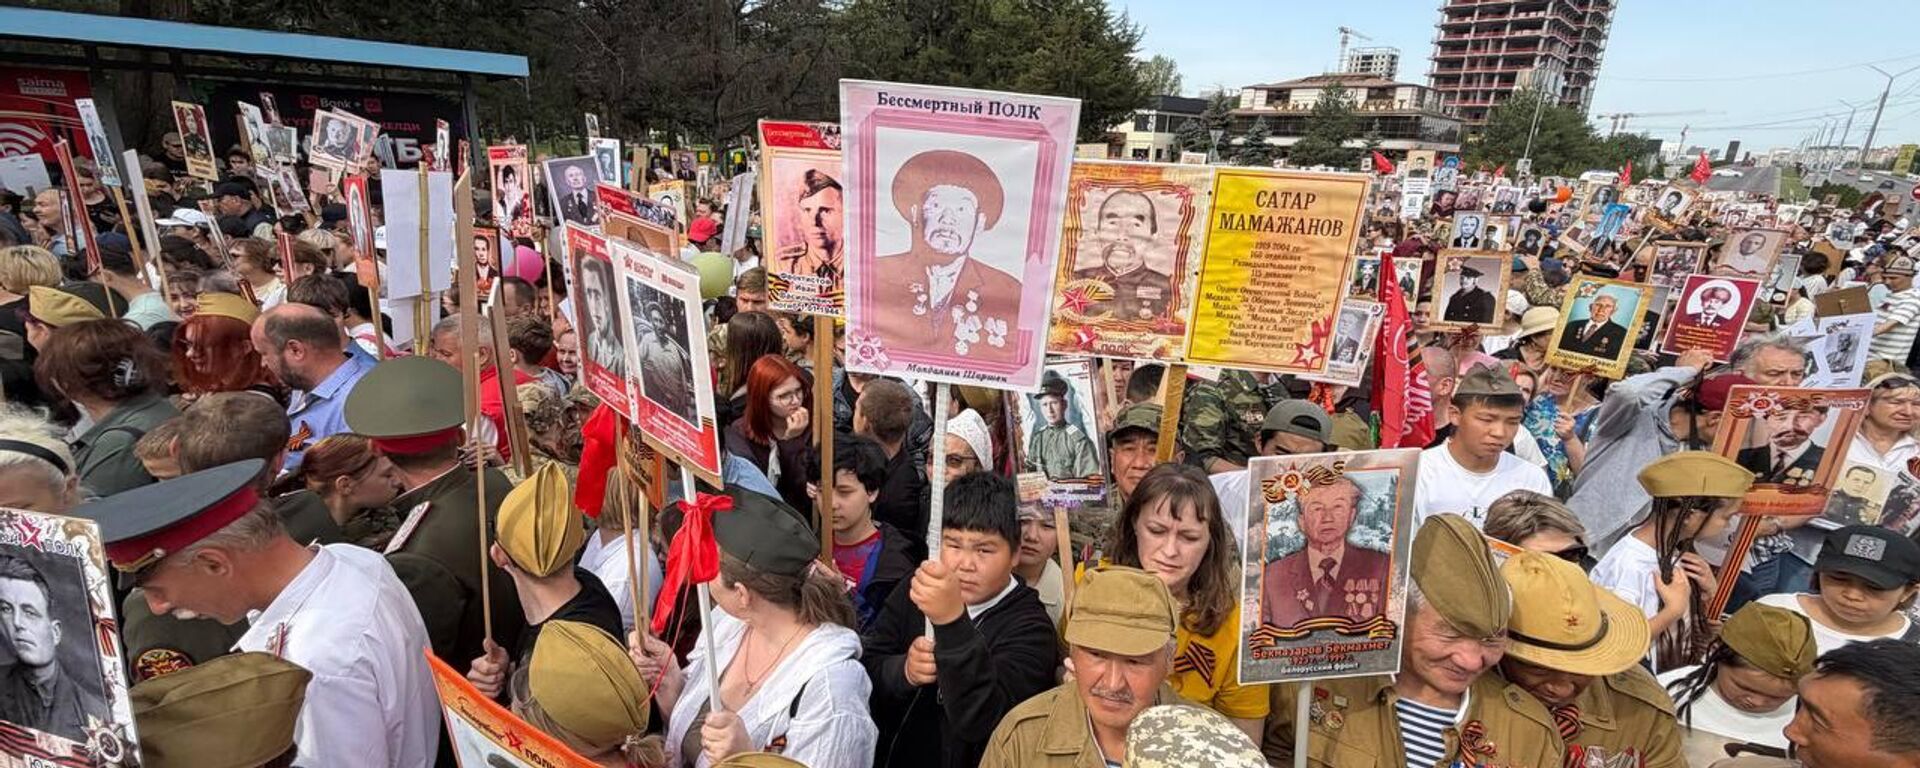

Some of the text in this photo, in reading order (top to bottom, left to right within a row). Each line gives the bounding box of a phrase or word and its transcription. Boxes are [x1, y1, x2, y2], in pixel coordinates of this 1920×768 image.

[877, 91, 1042, 120] Бессмертный ПОЛК
[1256, 190, 1317, 210] САТАР
[1219, 212, 1344, 237] МАМАЖАНОВ
[795, 284, 817, 293] Иван
[1252, 640, 1391, 659] Бекназаров Бекмахмет
[1281, 663, 1333, 674] Белорусский
